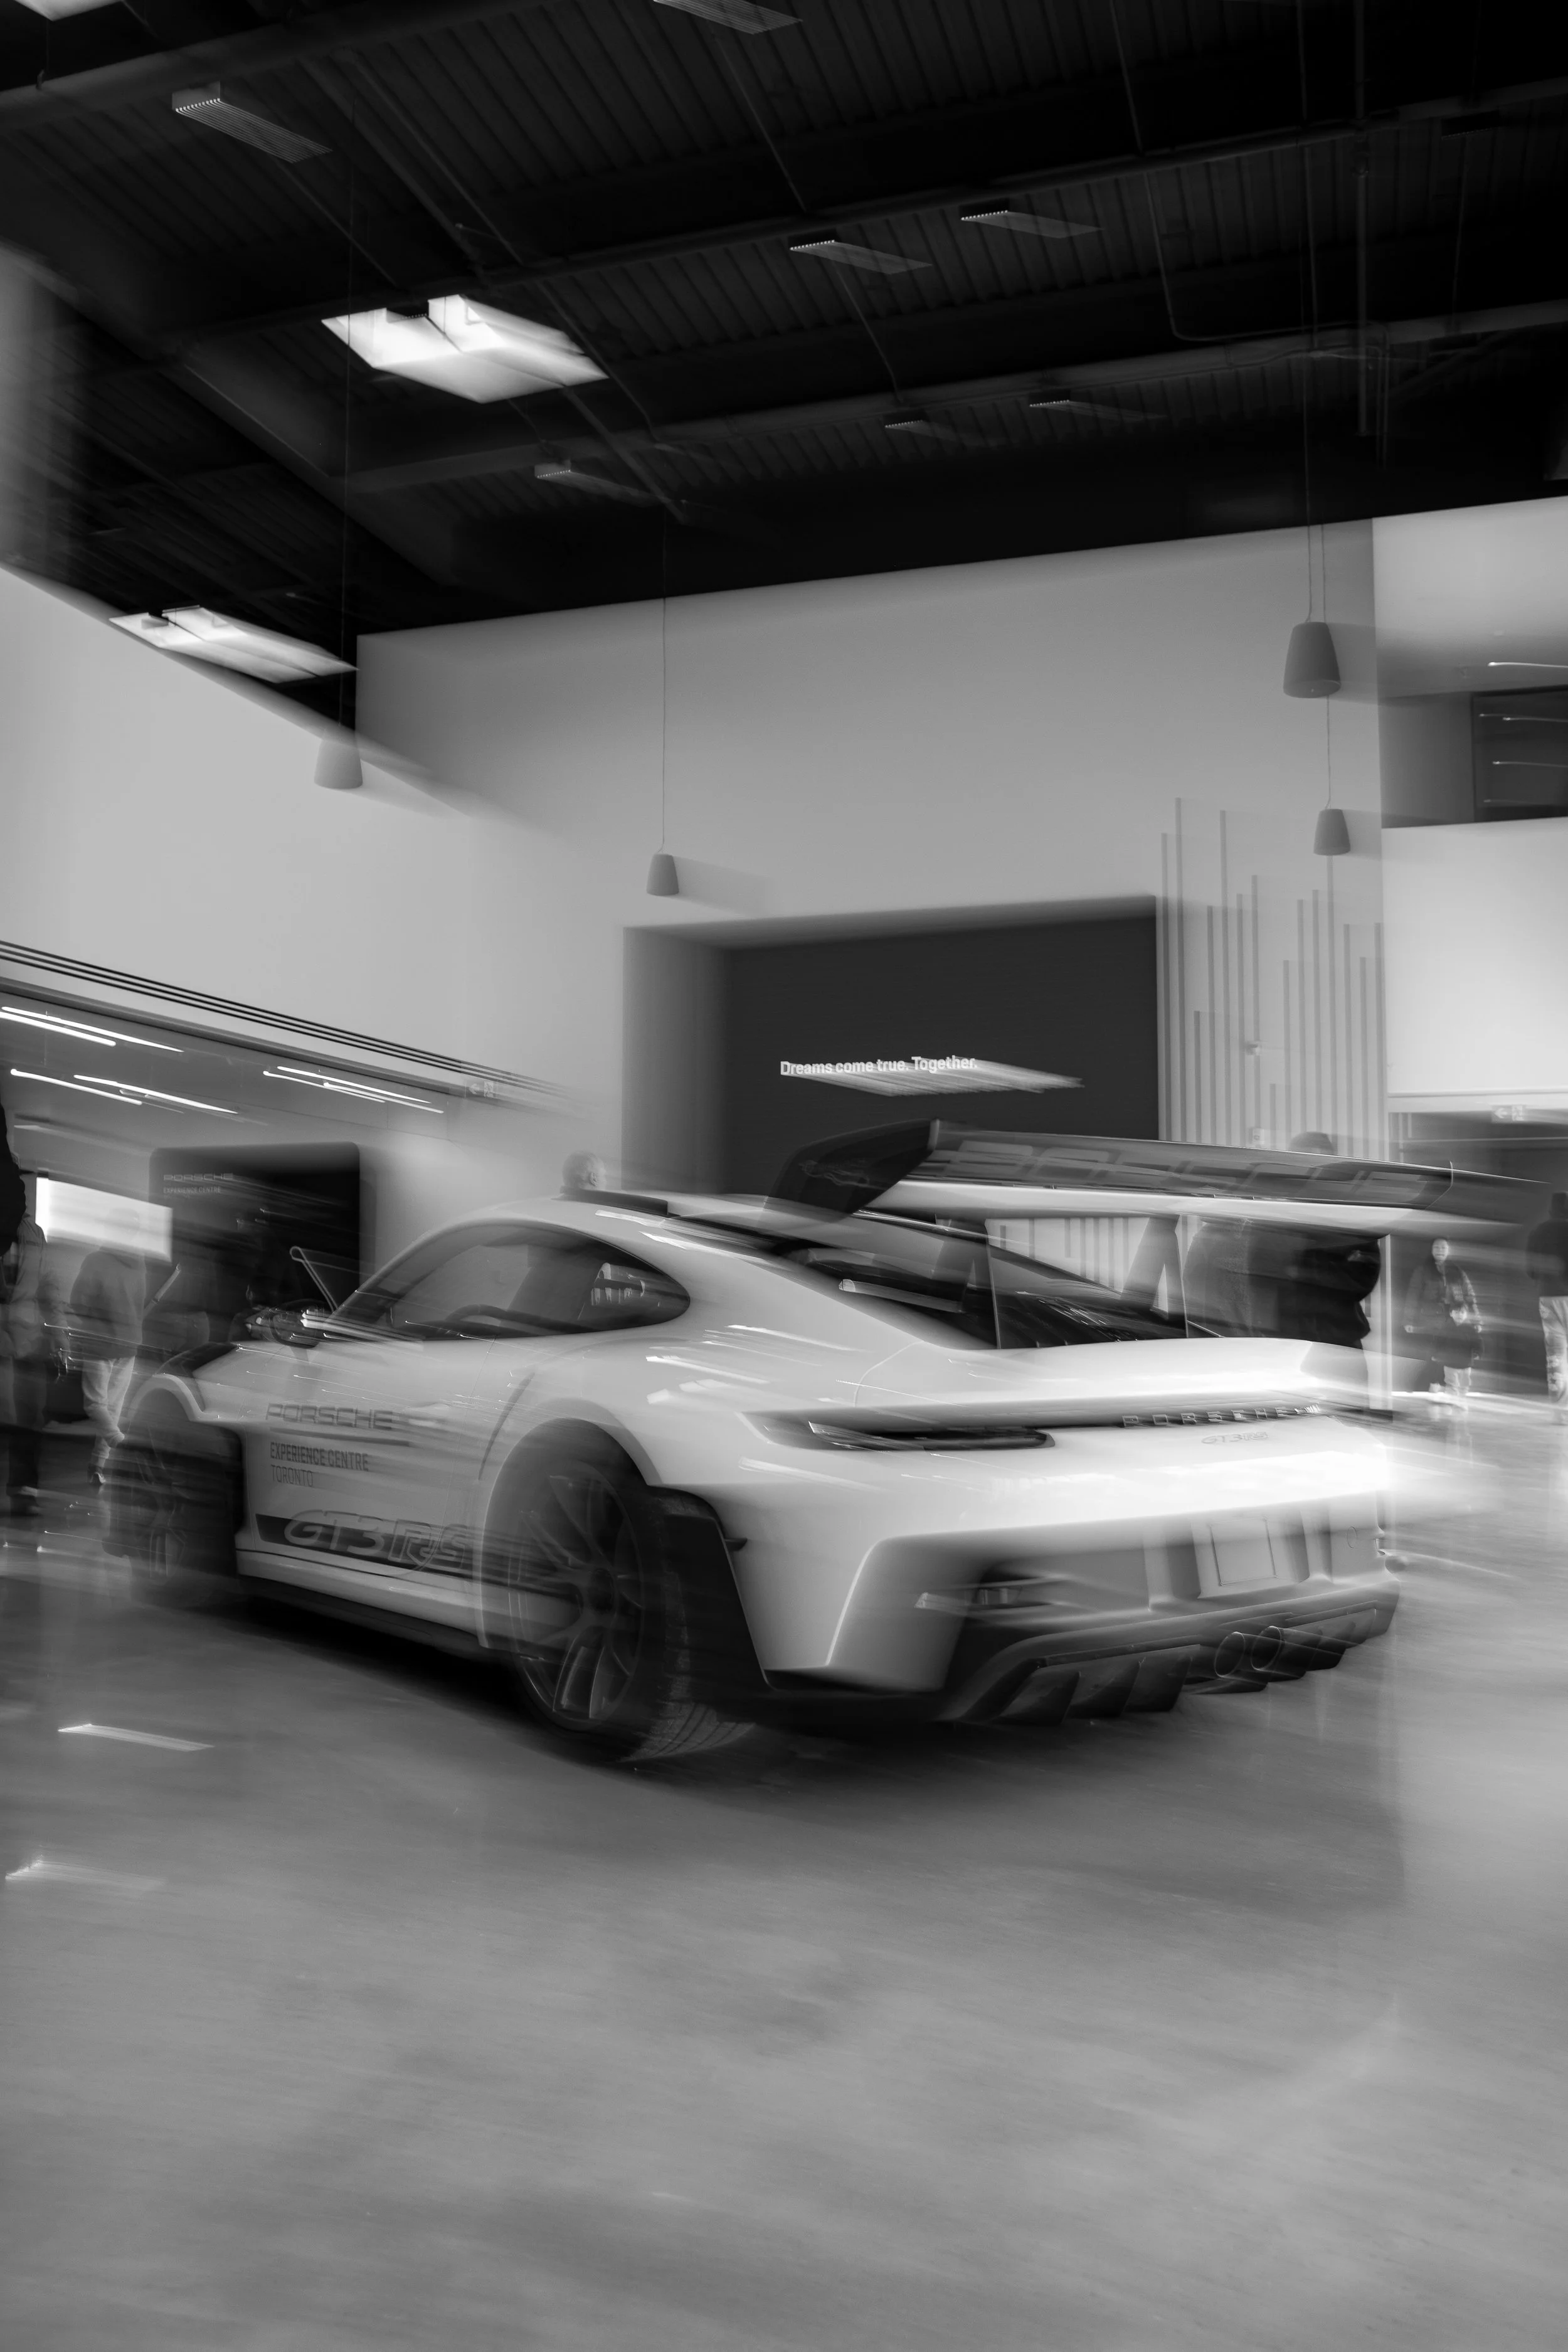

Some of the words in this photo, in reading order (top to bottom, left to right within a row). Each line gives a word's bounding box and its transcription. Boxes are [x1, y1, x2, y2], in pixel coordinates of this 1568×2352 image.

[780, 1061, 833, 1076] Dreams
[835, 1061, 874, 1073] come
[876, 1059, 909, 1073] true.
[911, 1055, 978, 1074] Together.
[163, 1173, 233, 1181] PORSCHE
[163, 1186, 197, 1194] EXPERIENCE
[198, 1186, 221, 1194] CENTRE
[265, 1402, 393, 1431] PORSCHE
[1121, 1406, 1290, 1429] PORSCHE
[270, 1441, 326, 1467] EXPERIENCE
[327, 1449, 369, 1472] CENTRE
[270, 1464, 314, 1488] TORONTO
